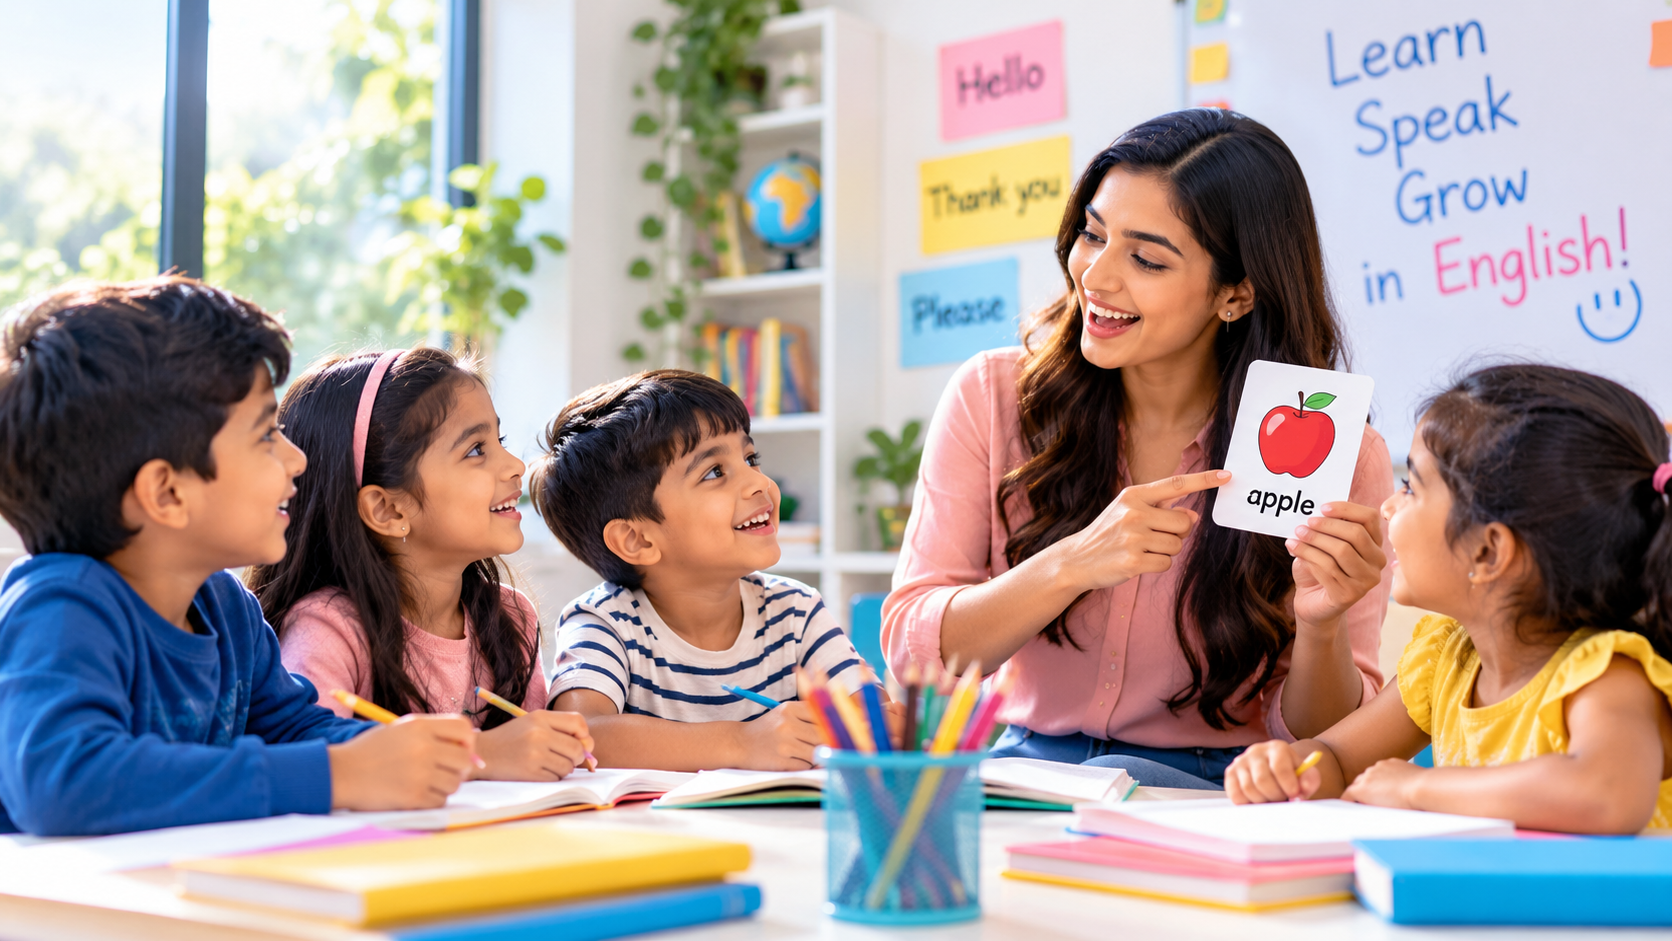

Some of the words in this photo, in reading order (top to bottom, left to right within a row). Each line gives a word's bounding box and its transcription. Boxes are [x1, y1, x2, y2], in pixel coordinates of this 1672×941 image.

[956, 55, 1045, 104] Hello
[1326, 19, 1487, 88] Learn
[1355, 75, 1519, 170] Speak
[926, 175, 1008, 217] Thank
[1016, 175, 1062, 216] you
[1396, 169, 1529, 225] Grow
[1363, 261, 1404, 305] in
[1433, 206, 1630, 307] English!
[910, 294, 1007, 334] Please
[1247, 489, 1315, 517] apple
